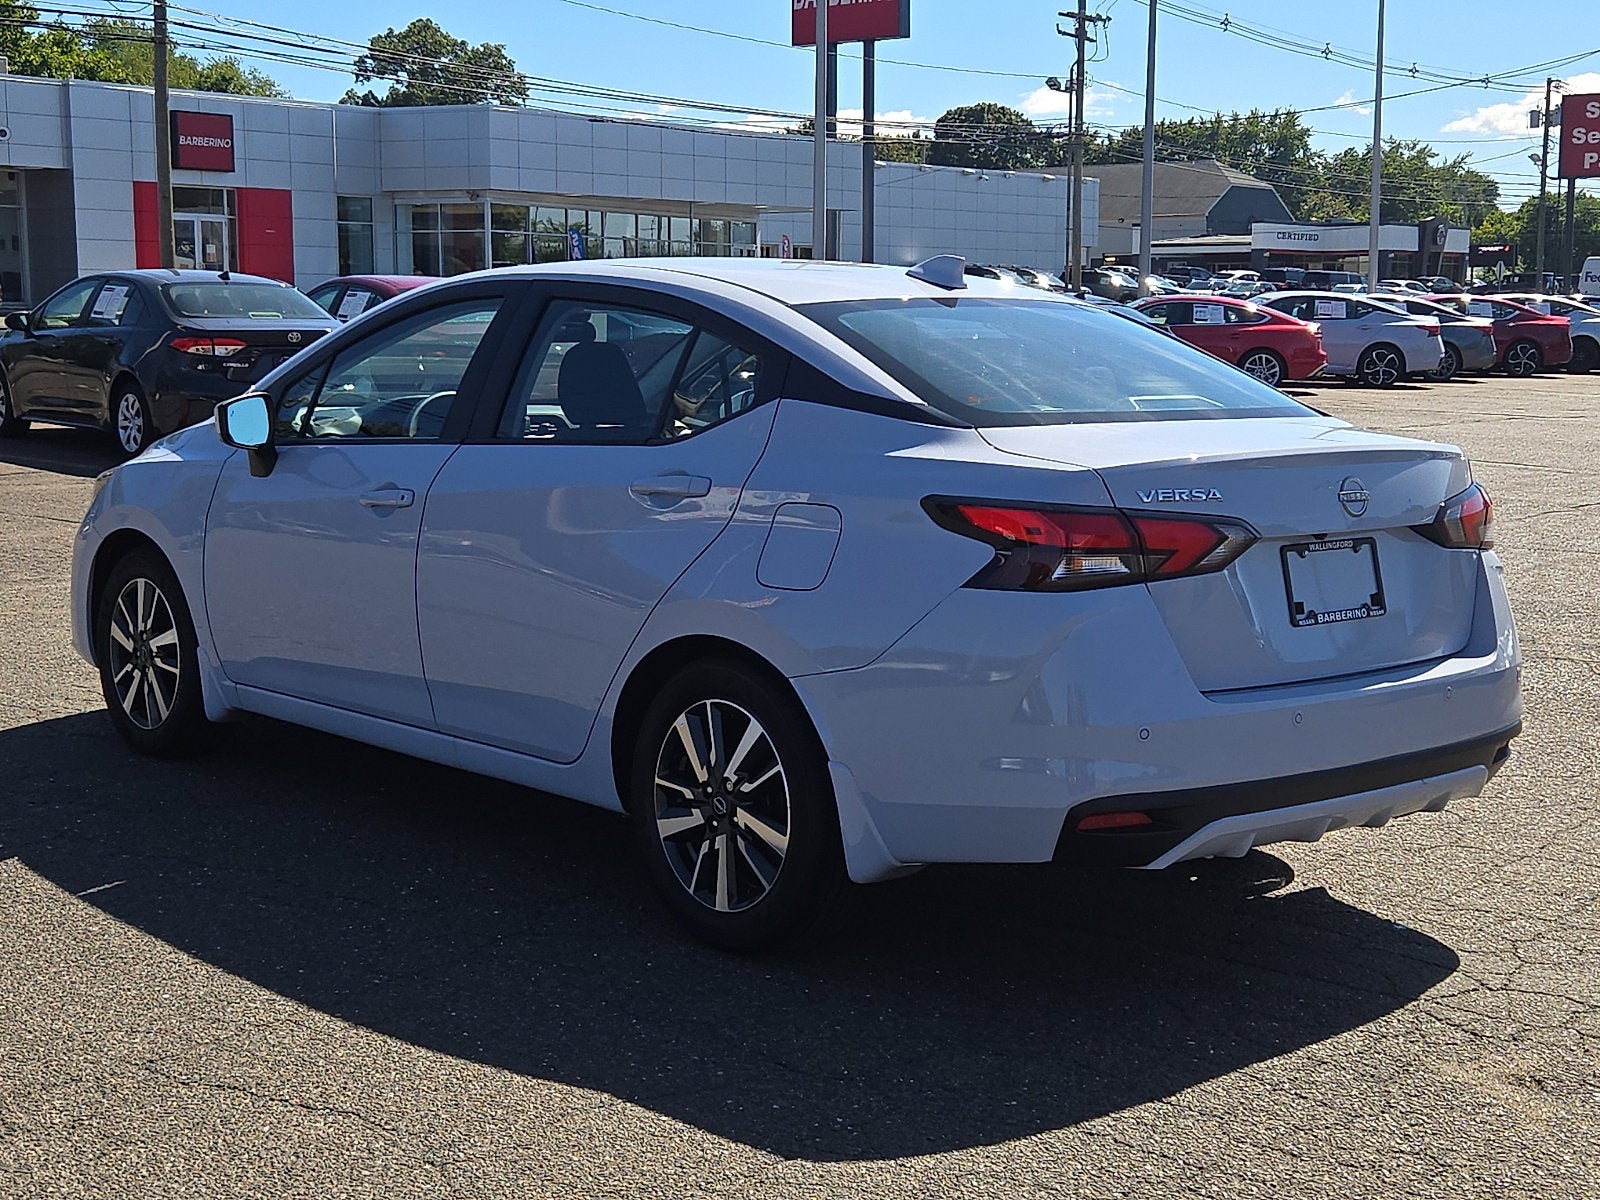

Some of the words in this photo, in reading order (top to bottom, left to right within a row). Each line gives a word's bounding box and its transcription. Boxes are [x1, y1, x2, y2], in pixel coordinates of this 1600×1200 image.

[179, 136, 231, 148] BARBERINO
[1572, 128, 1600, 144] Se
[1584, 152, 1600, 169] P
[1276, 232, 1319, 241] CERTIFIED
[1136, 488, 1223, 503] VERSA
[1309, 541, 1353, 551] WALLINGFORD
[1317, 608, 1367, 623] BARBERINO
